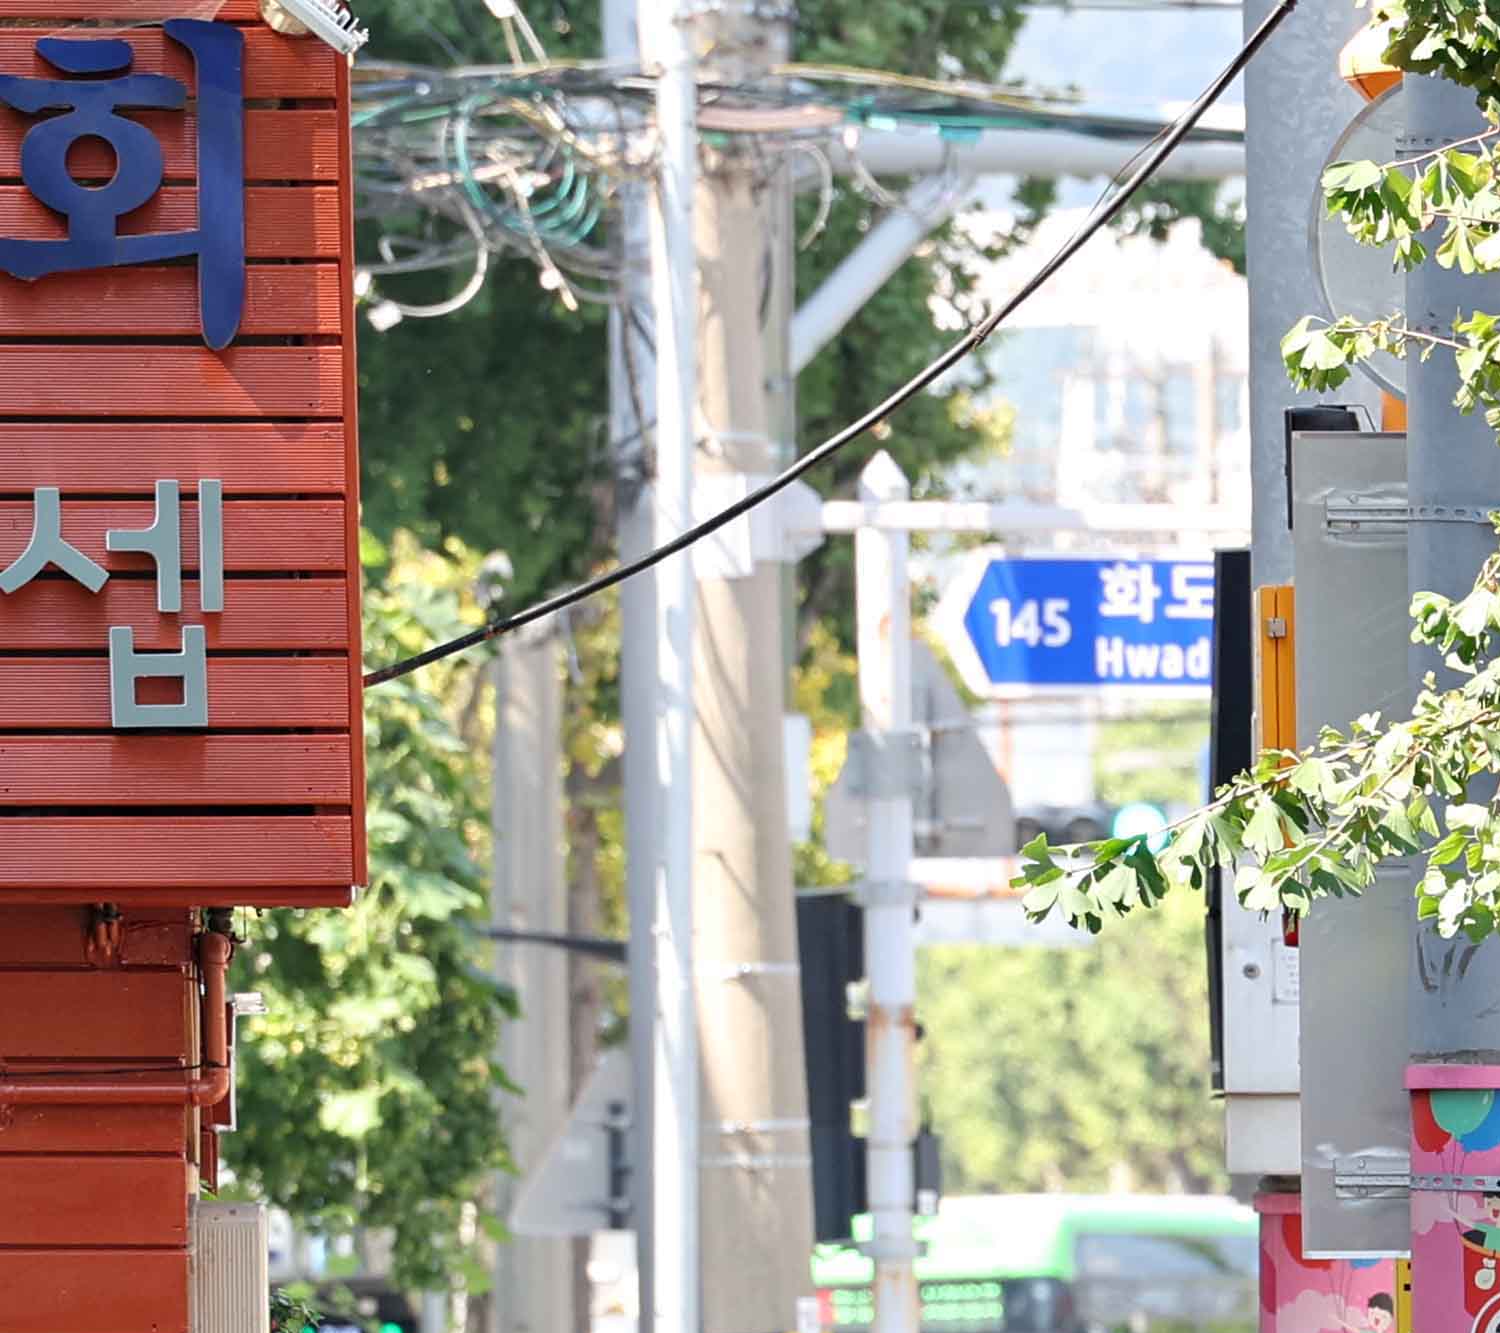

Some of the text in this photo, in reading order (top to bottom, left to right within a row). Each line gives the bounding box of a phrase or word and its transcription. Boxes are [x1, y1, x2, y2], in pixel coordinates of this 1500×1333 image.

[0, 18, 245, 350] 회
[0, 478, 224, 728] 셉
[989, 598, 1072, 647] 145
